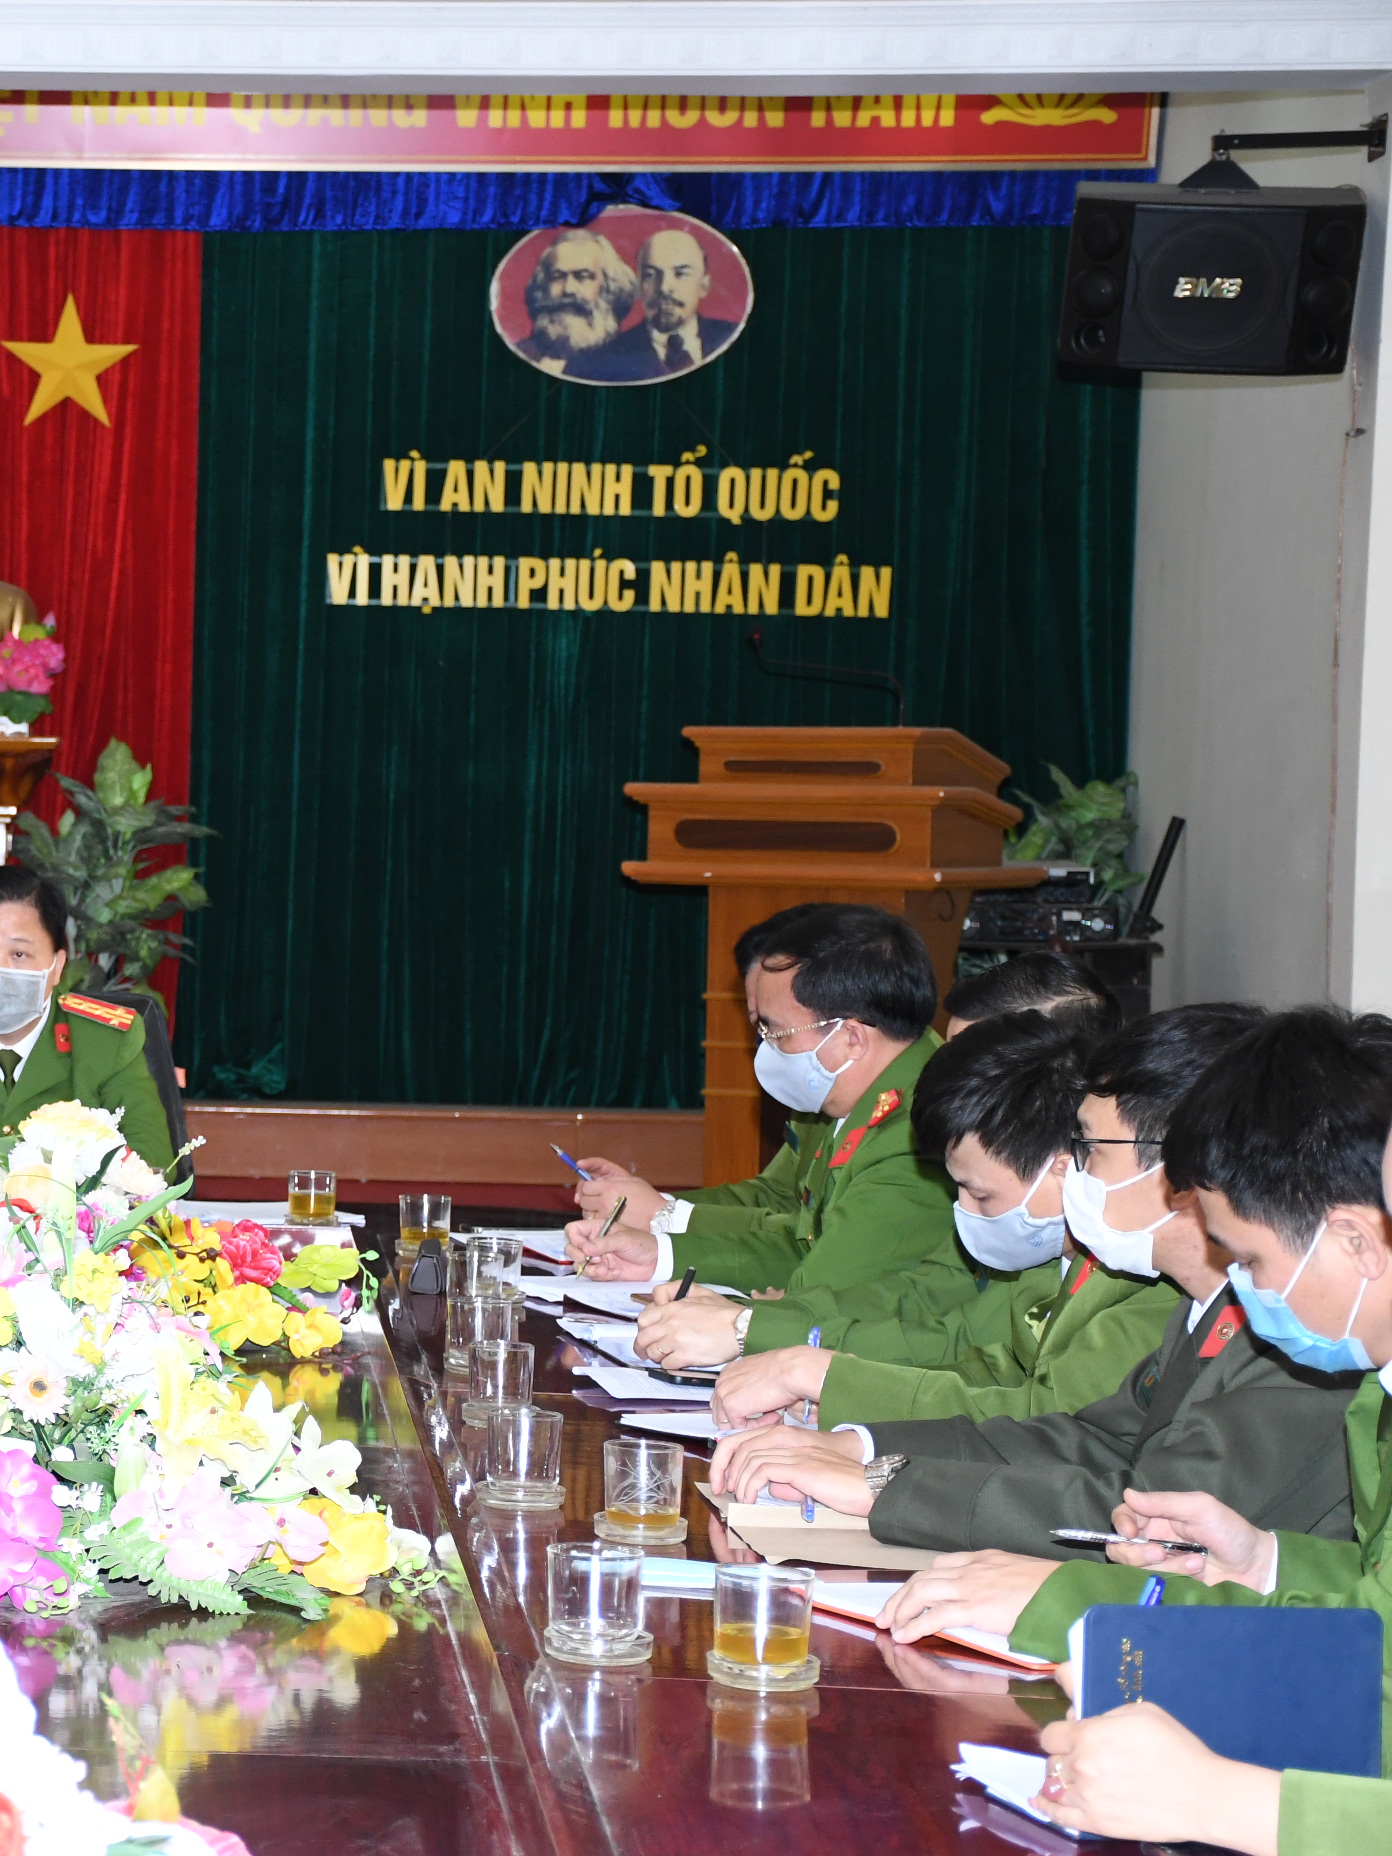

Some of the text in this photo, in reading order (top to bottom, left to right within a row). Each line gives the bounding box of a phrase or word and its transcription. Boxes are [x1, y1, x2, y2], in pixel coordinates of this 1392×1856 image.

[1173, 276, 1243, 299] BMB
[382, 444, 842, 525] VÌ AN NINH TỔ QUỐC
[326, 545, 893, 619] VÌ HẠNH PHÚC NHÂN DÂN
